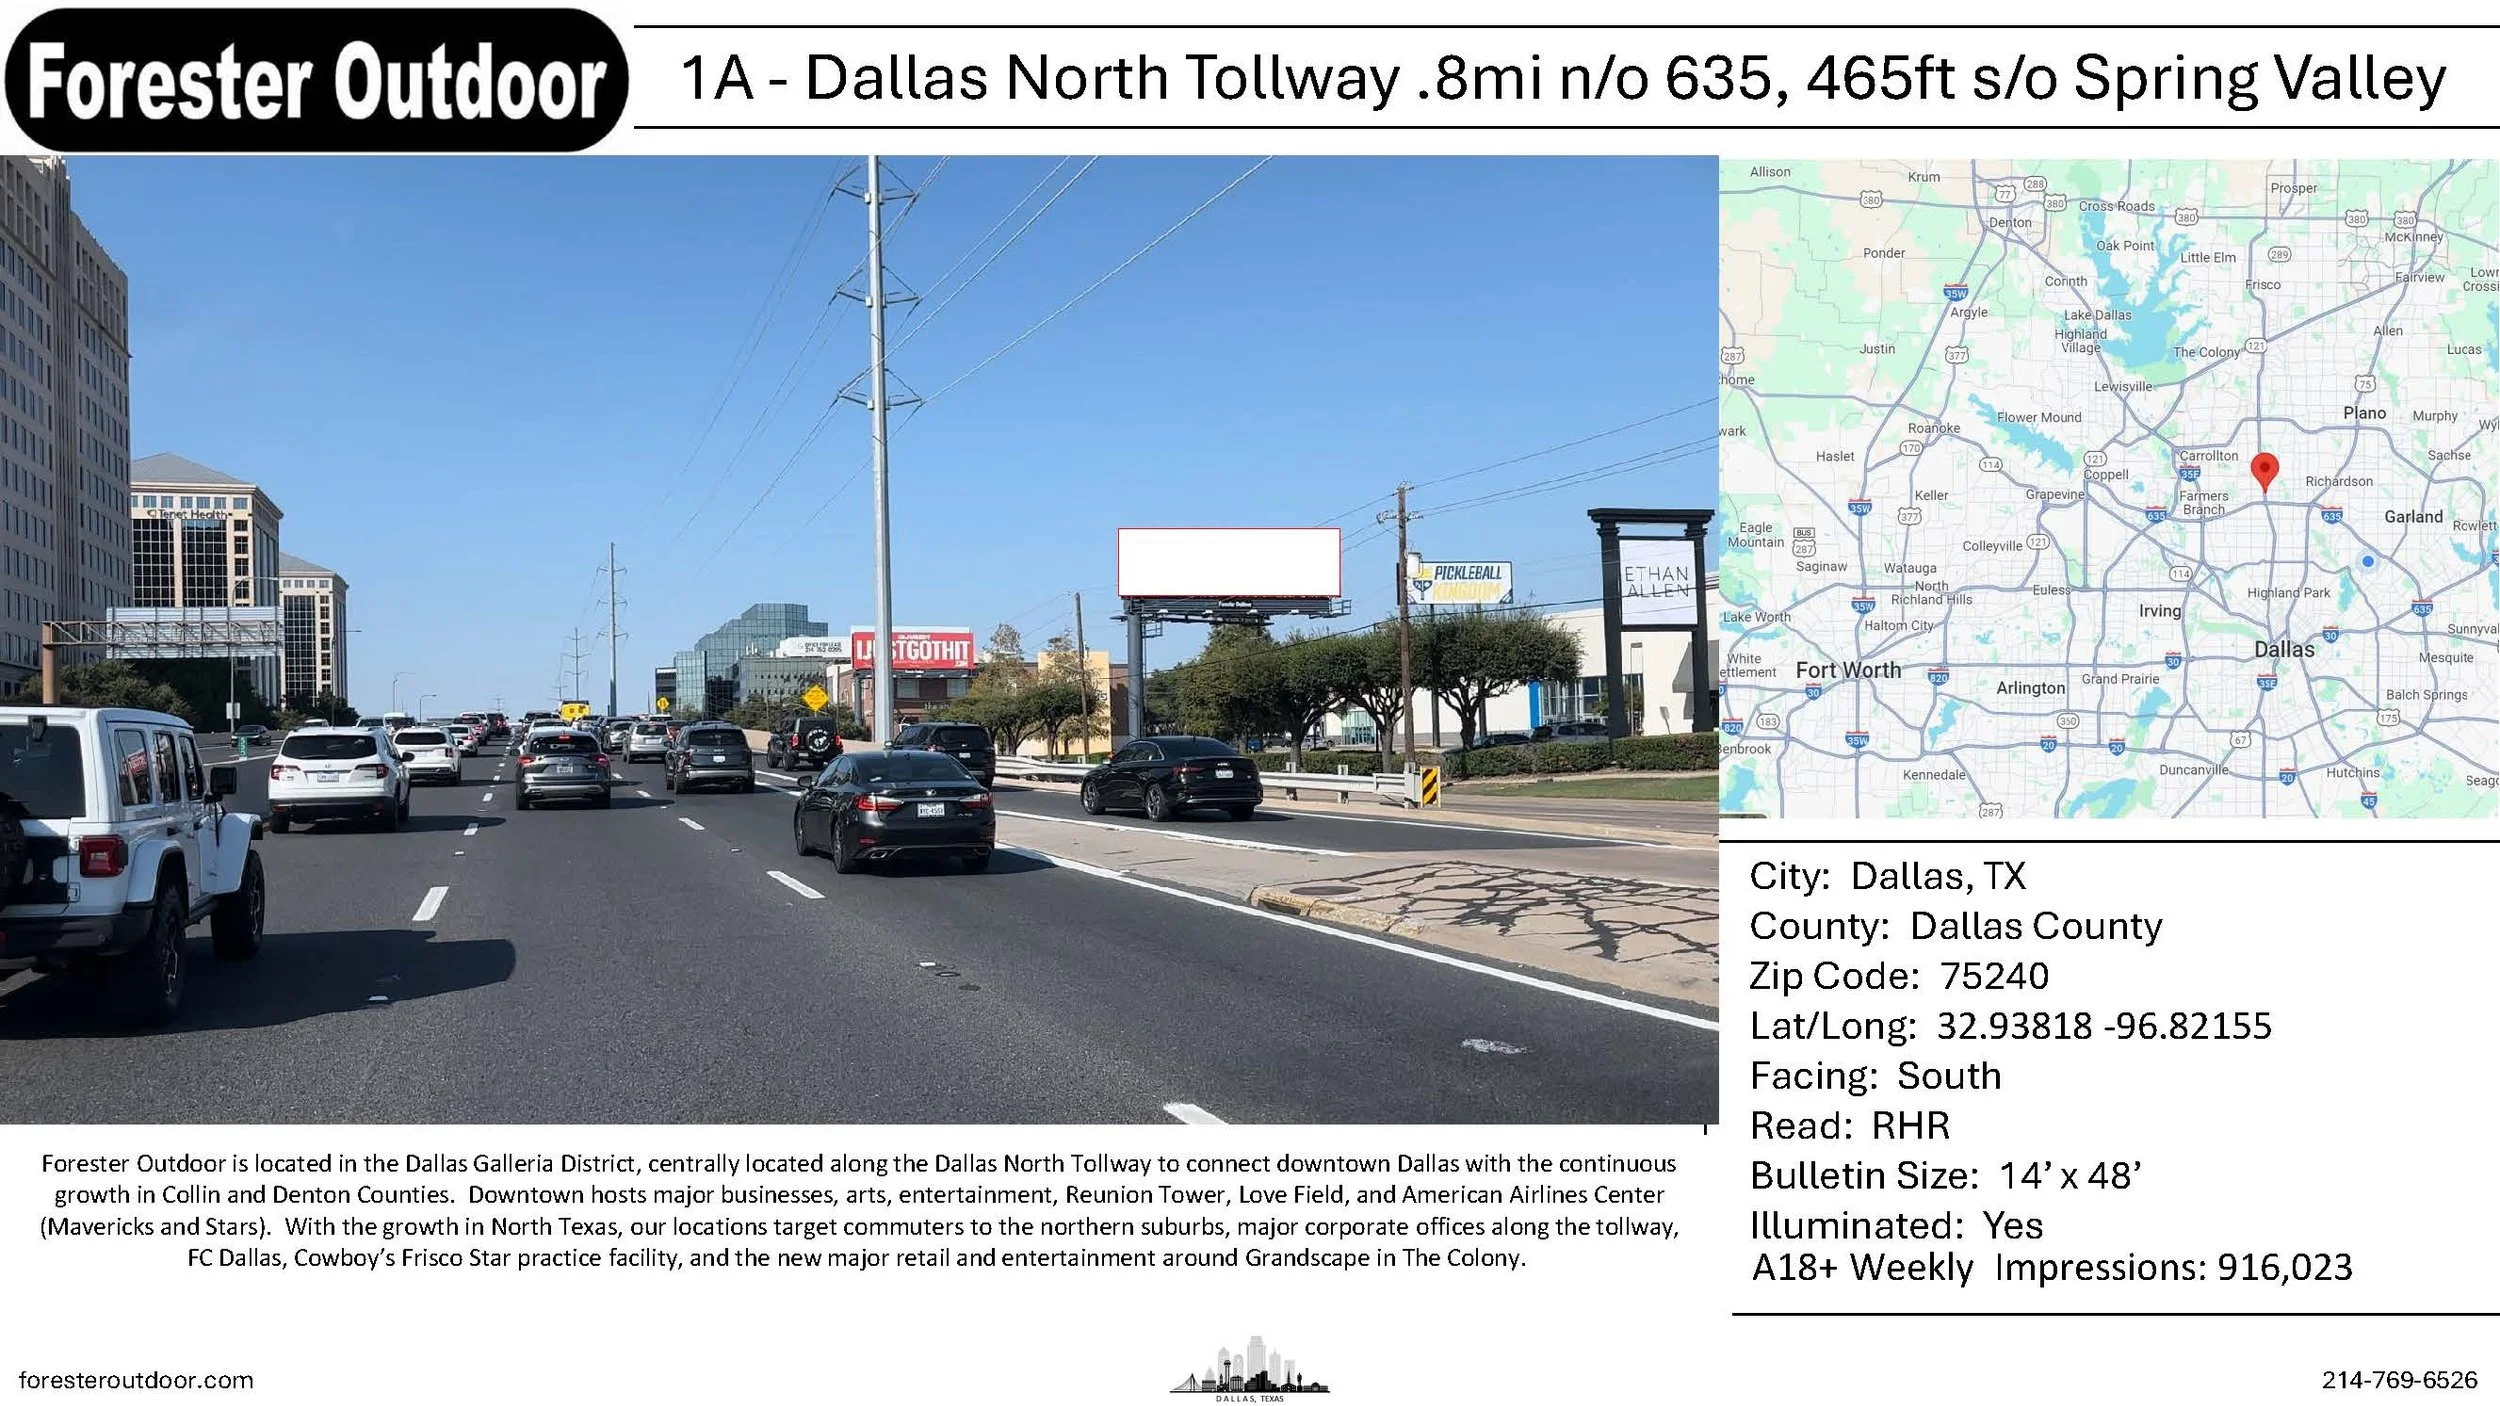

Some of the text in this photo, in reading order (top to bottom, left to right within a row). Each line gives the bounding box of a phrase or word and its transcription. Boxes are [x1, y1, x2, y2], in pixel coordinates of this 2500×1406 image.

[1751, 167, 1790, 176] Allison
[1909, 173, 1939, 181] Krum
[2027, 179, 2044, 189] 288
[2272, 183, 2316, 195] Prosper
[1999, 189, 2010, 199] 77
[1863, 196, 1880, 206] 380
[1990, 218, 2031, 227] Denton
[2178, 213, 2195, 223] 380
[2386, 233, 2441, 244] McKinney
[2097, 241, 2153, 250] Oak Point
[1865, 248, 1903, 258] Ponder
[2182, 253, 2235, 262] Little Elm
[2272, 250, 2288, 259] 289
[2046, 278, 2087, 286] Corinth
[2396, 272, 2444, 282] Fairview
[2247, 280, 2280, 289] Frisco
[1951, 307, 1987, 319] Argyle
[2056, 329, 2106, 341] Highland
[2374, 326, 2402, 335] Allen
[1860, 345, 1894, 353] Justin
[2062, 340, 2100, 355] Village
[2248, 341, 2264, 351] 121
[2448, 345, 2481, 354] Lucas
[2176, 347, 2240, 360] The Colony
[2096, 382, 2152, 391] Lewisville
[1998, 413, 2081, 422] Flower Mound
[2345, 406, 2386, 419] Plano
[2414, 411, 2455, 421] Murphy
[1909, 423, 1960, 433] Roanoke
[1817, 452, 1854, 461] Haslet
[2181, 451, 2237, 460] Carrollton
[2429, 450, 2470, 459] Sachse
[2307, 477, 2372, 486] Richardson
[1916, 490, 1947, 500] Keller
[2027, 490, 2084, 501] Grapevine
[2181, 491, 2228, 501] Farmers
[159, 509, 227, 519] Tenet Health
[2184, 504, 2224, 514] Branch
[2147, 511, 2165, 521] 635
[2385, 510, 2442, 522] Garland
[1741, 523, 1772, 535] Eagle
[1729, 534, 1783, 547] Mountain
[1964, 541, 2022, 551] Colleyville
[1797, 561, 1845, 572] Saginaw
[1885, 564, 1936, 575] Watauga
[1435, 566, 1501, 580] PICKLEBALL
[1625, 567, 1688, 581] ETHAN
[1628, 584, 1688, 597] ALLEN
[2034, 585, 2070, 595] Euless
[2249, 588, 2330, 598] Highland Park
[1724, 612, 1790, 622] Lake Worth
[2141, 604, 2181, 620] Irving
[1866, 621, 1933, 633] Haltom City
[2256, 640, 2314, 657] Dallas
[2420, 653, 2473, 664] Mesquite
[1797, 661, 1901, 678] Fort Worth
[1997, 681, 2065, 697] Arlington
[2388, 690, 2467, 701] Balch Springs
[2161, 765, 2228, 774] Duncanville
[2328, 768, 2379, 777] Hutchins
[1904, 770, 1965, 780] Kennedale
